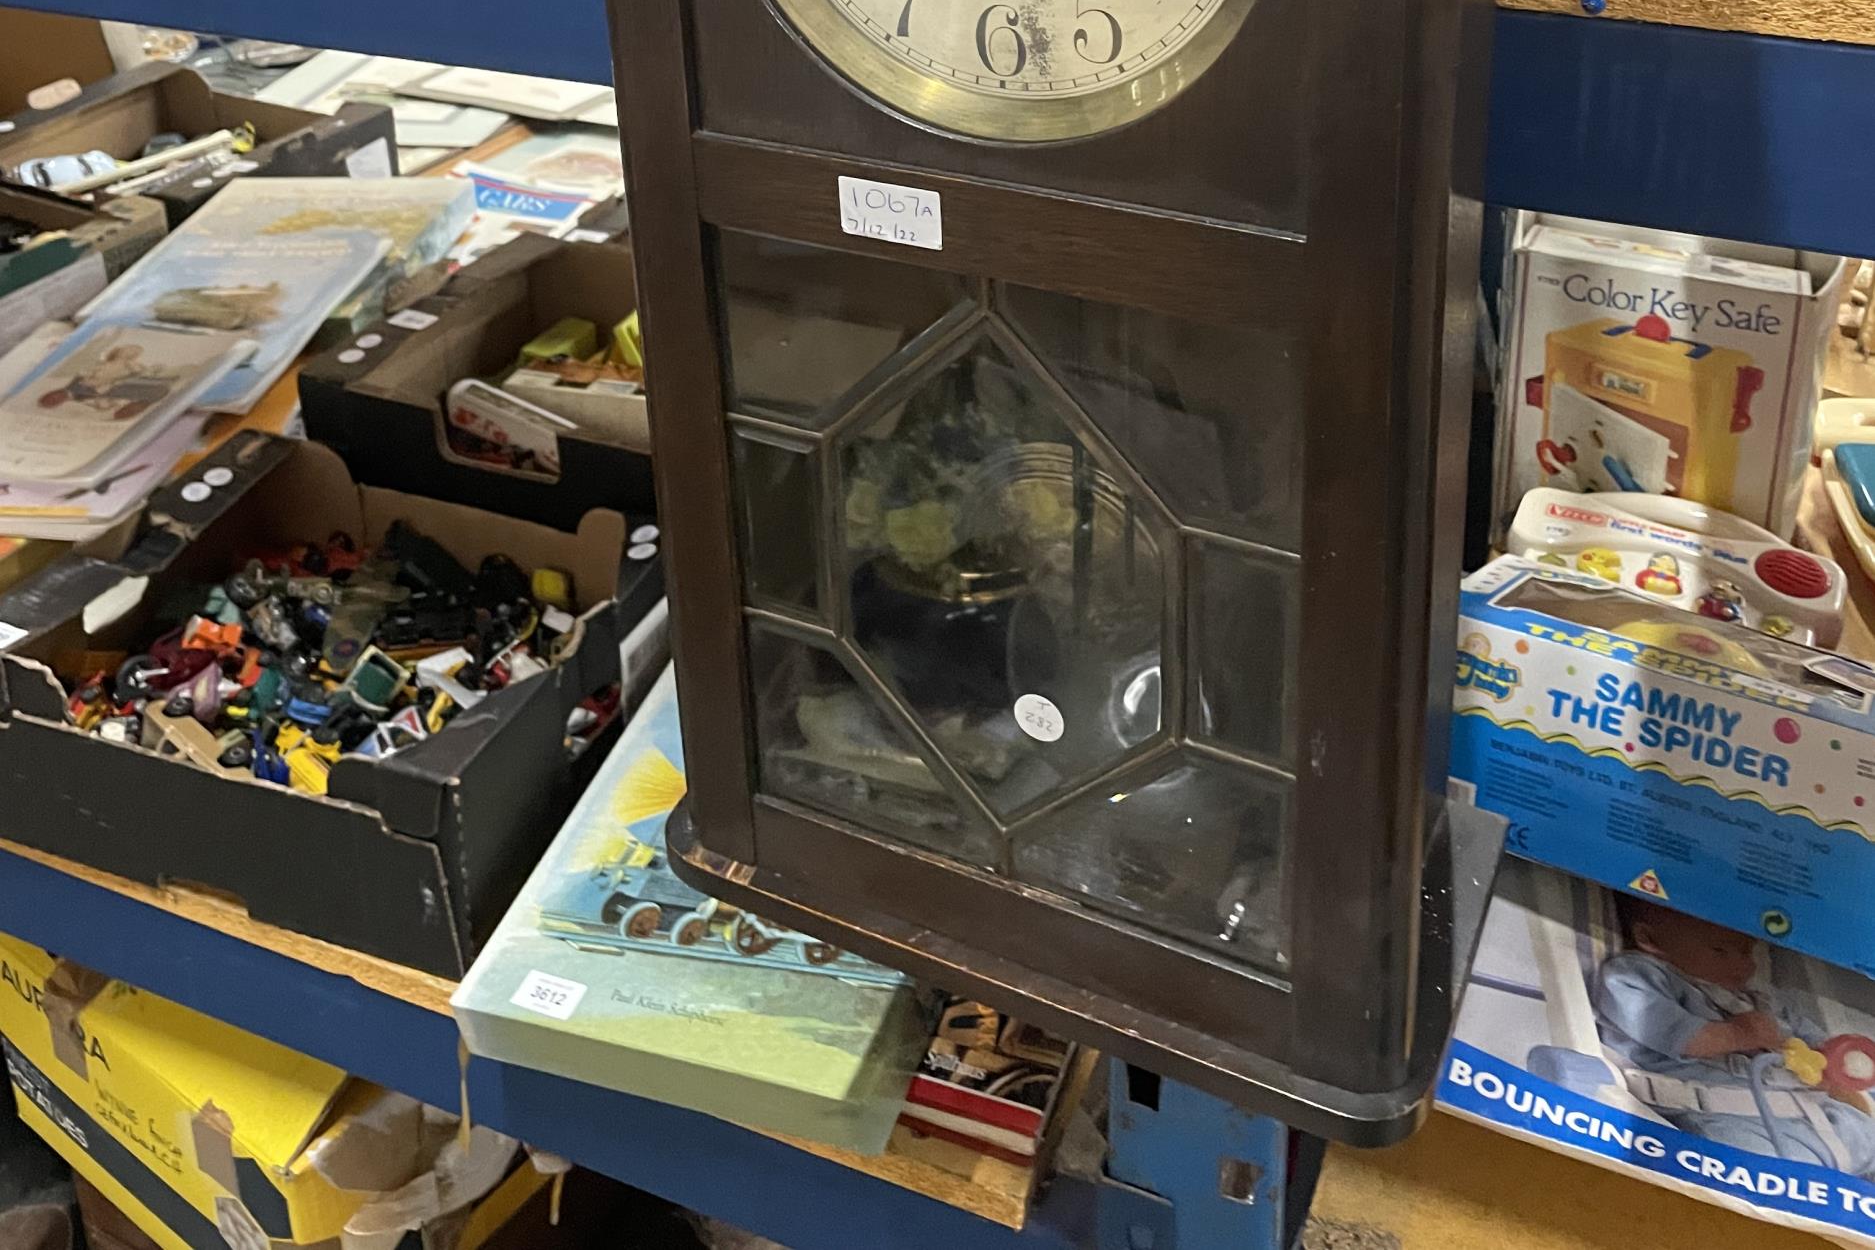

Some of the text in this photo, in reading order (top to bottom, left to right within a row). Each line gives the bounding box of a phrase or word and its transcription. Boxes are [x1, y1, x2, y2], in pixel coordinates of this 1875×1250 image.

[976, 4, 1027, 77] 6
[1563, 273, 1781, 335] Color Key Safe
[1547, 688, 1792, 787] THE SPIDER
[1595, 673, 1742, 737] SAMMY
[529, 985, 568, 1006] 3612
[1448, 1058, 1667, 1158] BOUNCING
[1675, 1149, 1830, 1206] CRADLE
